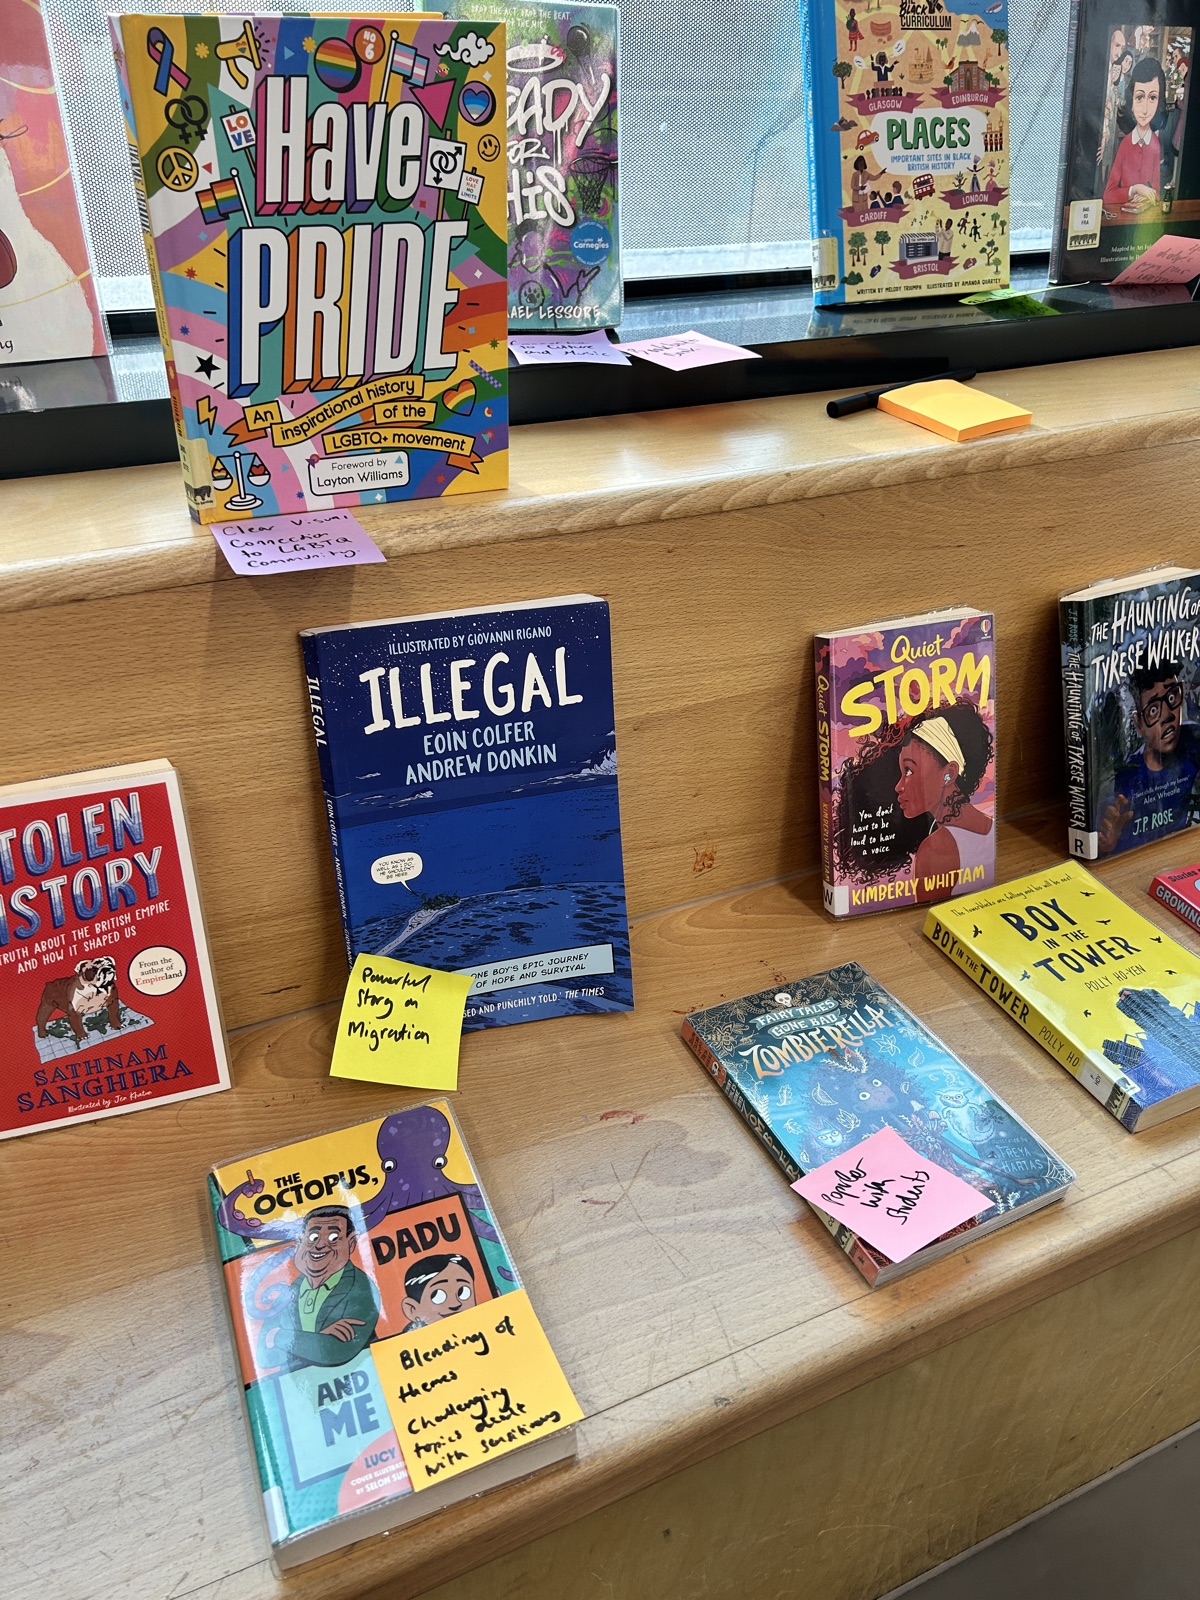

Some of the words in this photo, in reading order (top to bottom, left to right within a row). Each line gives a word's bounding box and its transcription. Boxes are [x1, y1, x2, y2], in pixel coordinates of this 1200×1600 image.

[899, 1, 928, 17] BLACK
[900, 15, 952, 28] CURRICULUM
[363, 30, 377, 42] NO
[364, 45, 375, 60] 6
[506, 72, 611, 147] EADY
[868, 99, 903, 112] GLASGOW
[951, 93, 989, 105] EDINBURGH
[225, 114, 249, 132] LO
[886, 116, 970, 150] PLACES
[230, 130, 255, 148] VE
[256, 75, 424, 216] Have
[890, 154, 925, 163] IMPORTANT
[926, 153, 942, 162] SITES
[943, 153, 951, 161] IN
[952, 152, 971, 161] BLACK
[907, 163, 930, 171] BRITISH
[931, 161, 956, 170] HISTORY
[506, 166, 576, 227] HIS
[961, 194, 989, 205] LONDON
[859, 211, 888, 223] CARDIFF
[573, 241, 610, 251] Carnegies
[913, 262, 939, 275] BRISTOL
[856, 287, 876, 295] WRITTEN
[884, 285, 902, 293] MELODY
[903, 284, 922, 292] TRIUMPH
[926, 281, 953, 290] ILLUSTRATED
[961, 279, 981, 287] AMANDA
[981, 277, 1001, 285] QUARTEY
[228, 221, 468, 399] PRIDE
[539, 305, 601, 320] LESSORE
[252, 408, 274, 425] An
[280, 396, 364, 442] inspirational
[366, 378, 415, 403] history
[382, 405, 399, 420] of
[402, 403, 426, 418] the
[332, 431, 389, 449] LGBTQ+
[392, 431, 466, 451] movement
[331, 460, 375, 471] Foreword
[376, 458, 388, 470] by
[316, 472, 355, 489] Layton
[356, 469, 403, 483] Williams
[222, 524, 275, 537] Clear
[241, 549, 263, 559] to
[278, 536, 353, 554] LGBTQ
[1090, 622, 1109, 646] THE
[1111, 586, 1192, 644] HAUNTING
[387, 636, 450, 656] ILLUSTRATED
[452, 633, 466, 648] BY
[466, 628, 515, 646] GIOVANNI
[515, 625, 553, 642] RIGANO
[890, 633, 944, 665] Quiet
[1090, 640, 1144, 693] TYRESE
[1147, 625, 1200, 671] WALKER
[358, 646, 584, 735] ILLEGAL
[817, 674, 830, 716] Quiet
[840, 652, 992, 738] STORM
[306, 674, 328, 748] ILLEGAL
[423, 729, 468, 756] EOIN
[471, 719, 536, 748] COLFER
[818, 720, 831, 783] STORM
[405, 750, 485, 786] ANDREW
[486, 743, 557, 772] DONKIN
[1143, 795, 1156, 805] Alex
[1156, 786, 1181, 800] Wheatle
[852, 824, 869, 833] have
[871, 822, 879, 830] to
[880, 819, 889, 829] be
[859, 809, 873, 822] You
[875, 803, 894, 818] don't
[1132, 816, 1149, 836] J.P.
[1151, 808, 1174, 830] ROSE
[0, 792, 145, 886] TOLEN
[850, 834, 866, 847] loud
[869, 836, 877, 845] to
[879, 832, 896, 843] have
[871, 846, 890, 855] voice
[1074, 838, 1085, 854] R
[851, 877, 919, 906] KIMBERLY
[923, 864, 985, 892] WHITTAM
[1167, 868, 1199, 883] Stories
[0, 846, 163, 947] ISTORY
[0, 946, 29, 967] TRUTH
[34, 934, 66, 955] ABOUT
[71, 925, 90, 942] THE
[94, 913, 132, 934] BRITISH
[135, 899, 171, 922] EMPIRE
[999, 897, 1079, 943] BOY
[17, 956, 38, 975] AND
[42, 949, 65, 967] HOW
[68, 943, 78, 957] IT
[84, 931, 120, 953] SHAPED
[124, 925, 138, 939] US
[1042, 937, 1060, 951] IN
[1061, 928, 1090, 943] THE
[138, 959, 160, 970] From
[160, 956, 173, 966] the
[140, 966, 164, 977] author
[165, 963, 175, 973] of
[470, 970, 489, 980] ONE
[492, 963, 519, 976] BOY'S
[522, 960, 545, 971] EPIC
[547, 952, 590, 966] JOURNEY
[1032, 934, 1143, 984] TOWER
[134, 970, 184, 987] Empireland
[361, 966, 432, 994] Powerful
[475, 980, 488, 989] OF
[491, 974, 516, 986] HOPE
[519, 971, 538, 981] AND
[540, 963, 587, 977] SURVIVAL
[1084, 974, 1113, 993] POLLY
[1113, 963, 1147, 984] HO-YEN
[356, 987, 394, 1020] Story
[403, 997, 419, 1009] on
[478, 1004, 496, 1016] AND
[497, 995, 537, 1011] PUNCHILY
[564, 988, 580, 999] THE
[581, 986, 606, 997] TIMES
[757, 1007, 795, 1027] FAIRY
[795, 998, 837, 1016] TALES
[347, 1020, 430, 1052] Migration
[770, 1021, 809, 1038] GONE
[809, 1012, 839, 1028] BAD
[738, 1003, 895, 1080] ZOMBIERELLA
[33, 1043, 168, 1088] SATHNAM
[16, 1058, 194, 1114] SANGHERA
[995, 1144, 1032, 1159] FREYA
[1000, 1159, 1044, 1173] HARTAS
[253, 1164, 380, 1216] OCTOPUS,
[273, 1171, 303, 1190] THE
[860, 1179, 897, 1209] with
[371, 1211, 463, 1267] DADU
[399, 1330, 490, 1371] Blending
[494, 1315, 517, 1336] of
[317, 1368, 371, 1408] AND
[397, 1370, 459, 1404] themes
[320, 1393, 382, 1448] ME
[407, 1387, 512, 1435] Challenging
[413, 1429, 463, 1459] topics
[474, 1402, 527, 1433] dealt
[364, 1446, 397, 1470] LUCY
[424, 1448, 469, 1478] with
